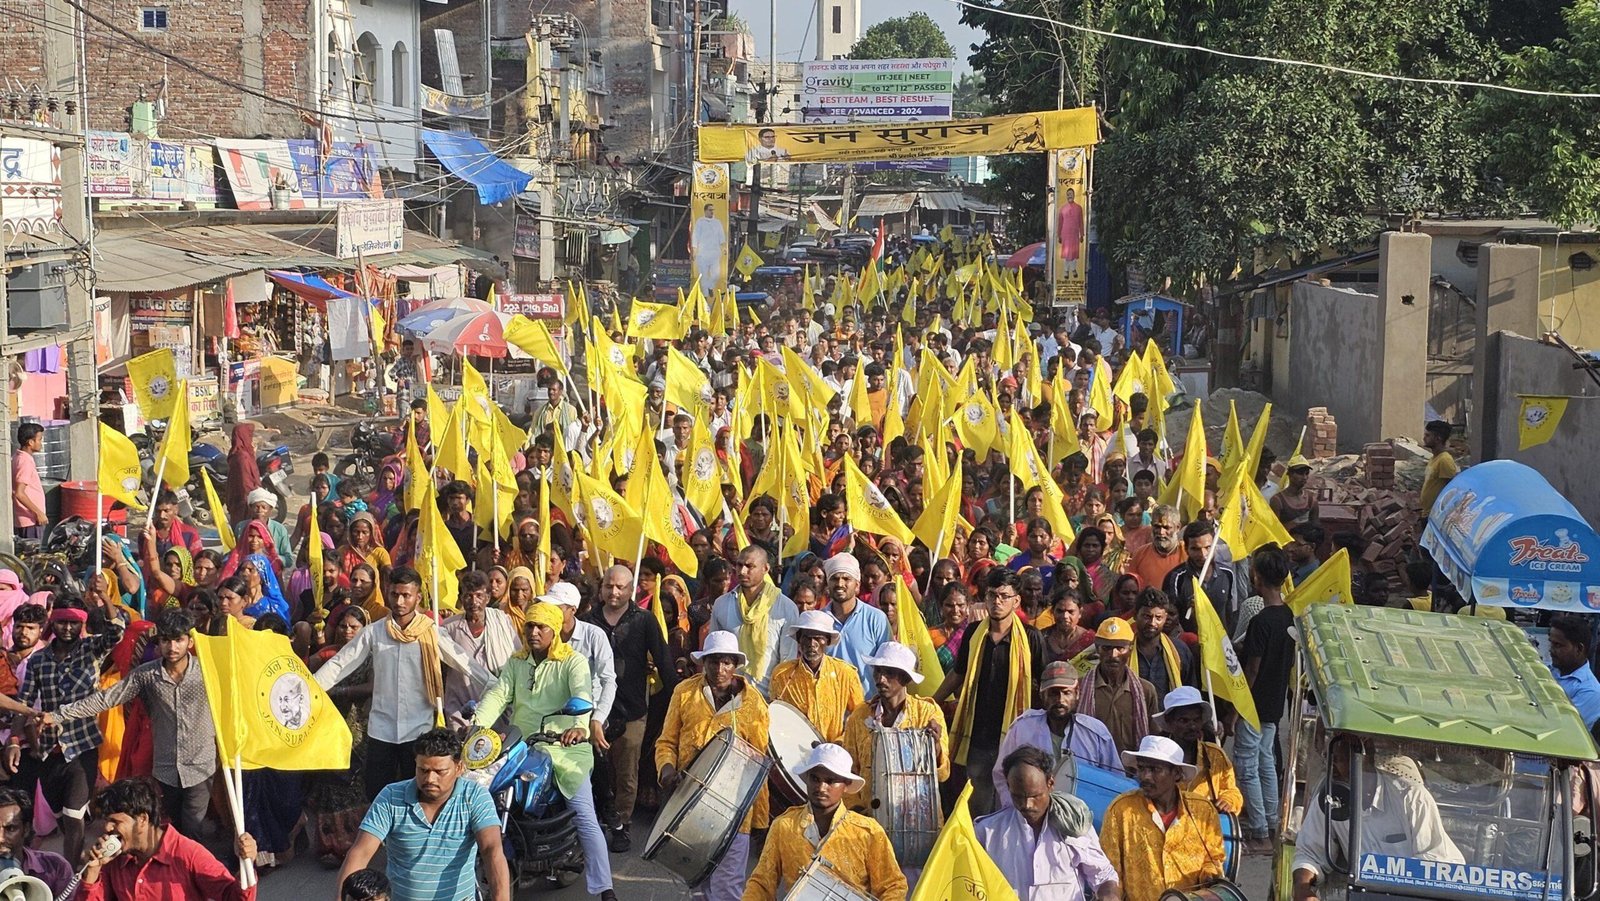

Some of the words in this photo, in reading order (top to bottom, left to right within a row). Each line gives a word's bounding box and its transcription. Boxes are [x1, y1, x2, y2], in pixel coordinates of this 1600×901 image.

[911, 60, 921, 69] और
[804, 76, 853, 94] gravity
[872, 84, 881, 92] to
[819, 96, 841, 104] BEST
[843, 96, 868, 104] TEAM
[900, 95, 935, 103] RESULT
[901, 107, 922, 115] 2024
[786, 129, 862, 144] जन
[872, 122, 995, 146] सुराज
[138, 295, 167, 311] फोटो
[168, 296, 193, 311] स्टेट
[195, 386, 212, 397] BSNL
[1508, 535, 1589, 566] Treat
[1529, 562, 1545, 571] ICE
[1547, 562, 1582, 572] CREAM
[264, 659, 282, 678] जन
[262, 711, 283, 736] JAN
[1361, 854, 1413, 877] A.M.
[1419, 860, 1533, 891] TRADERS
